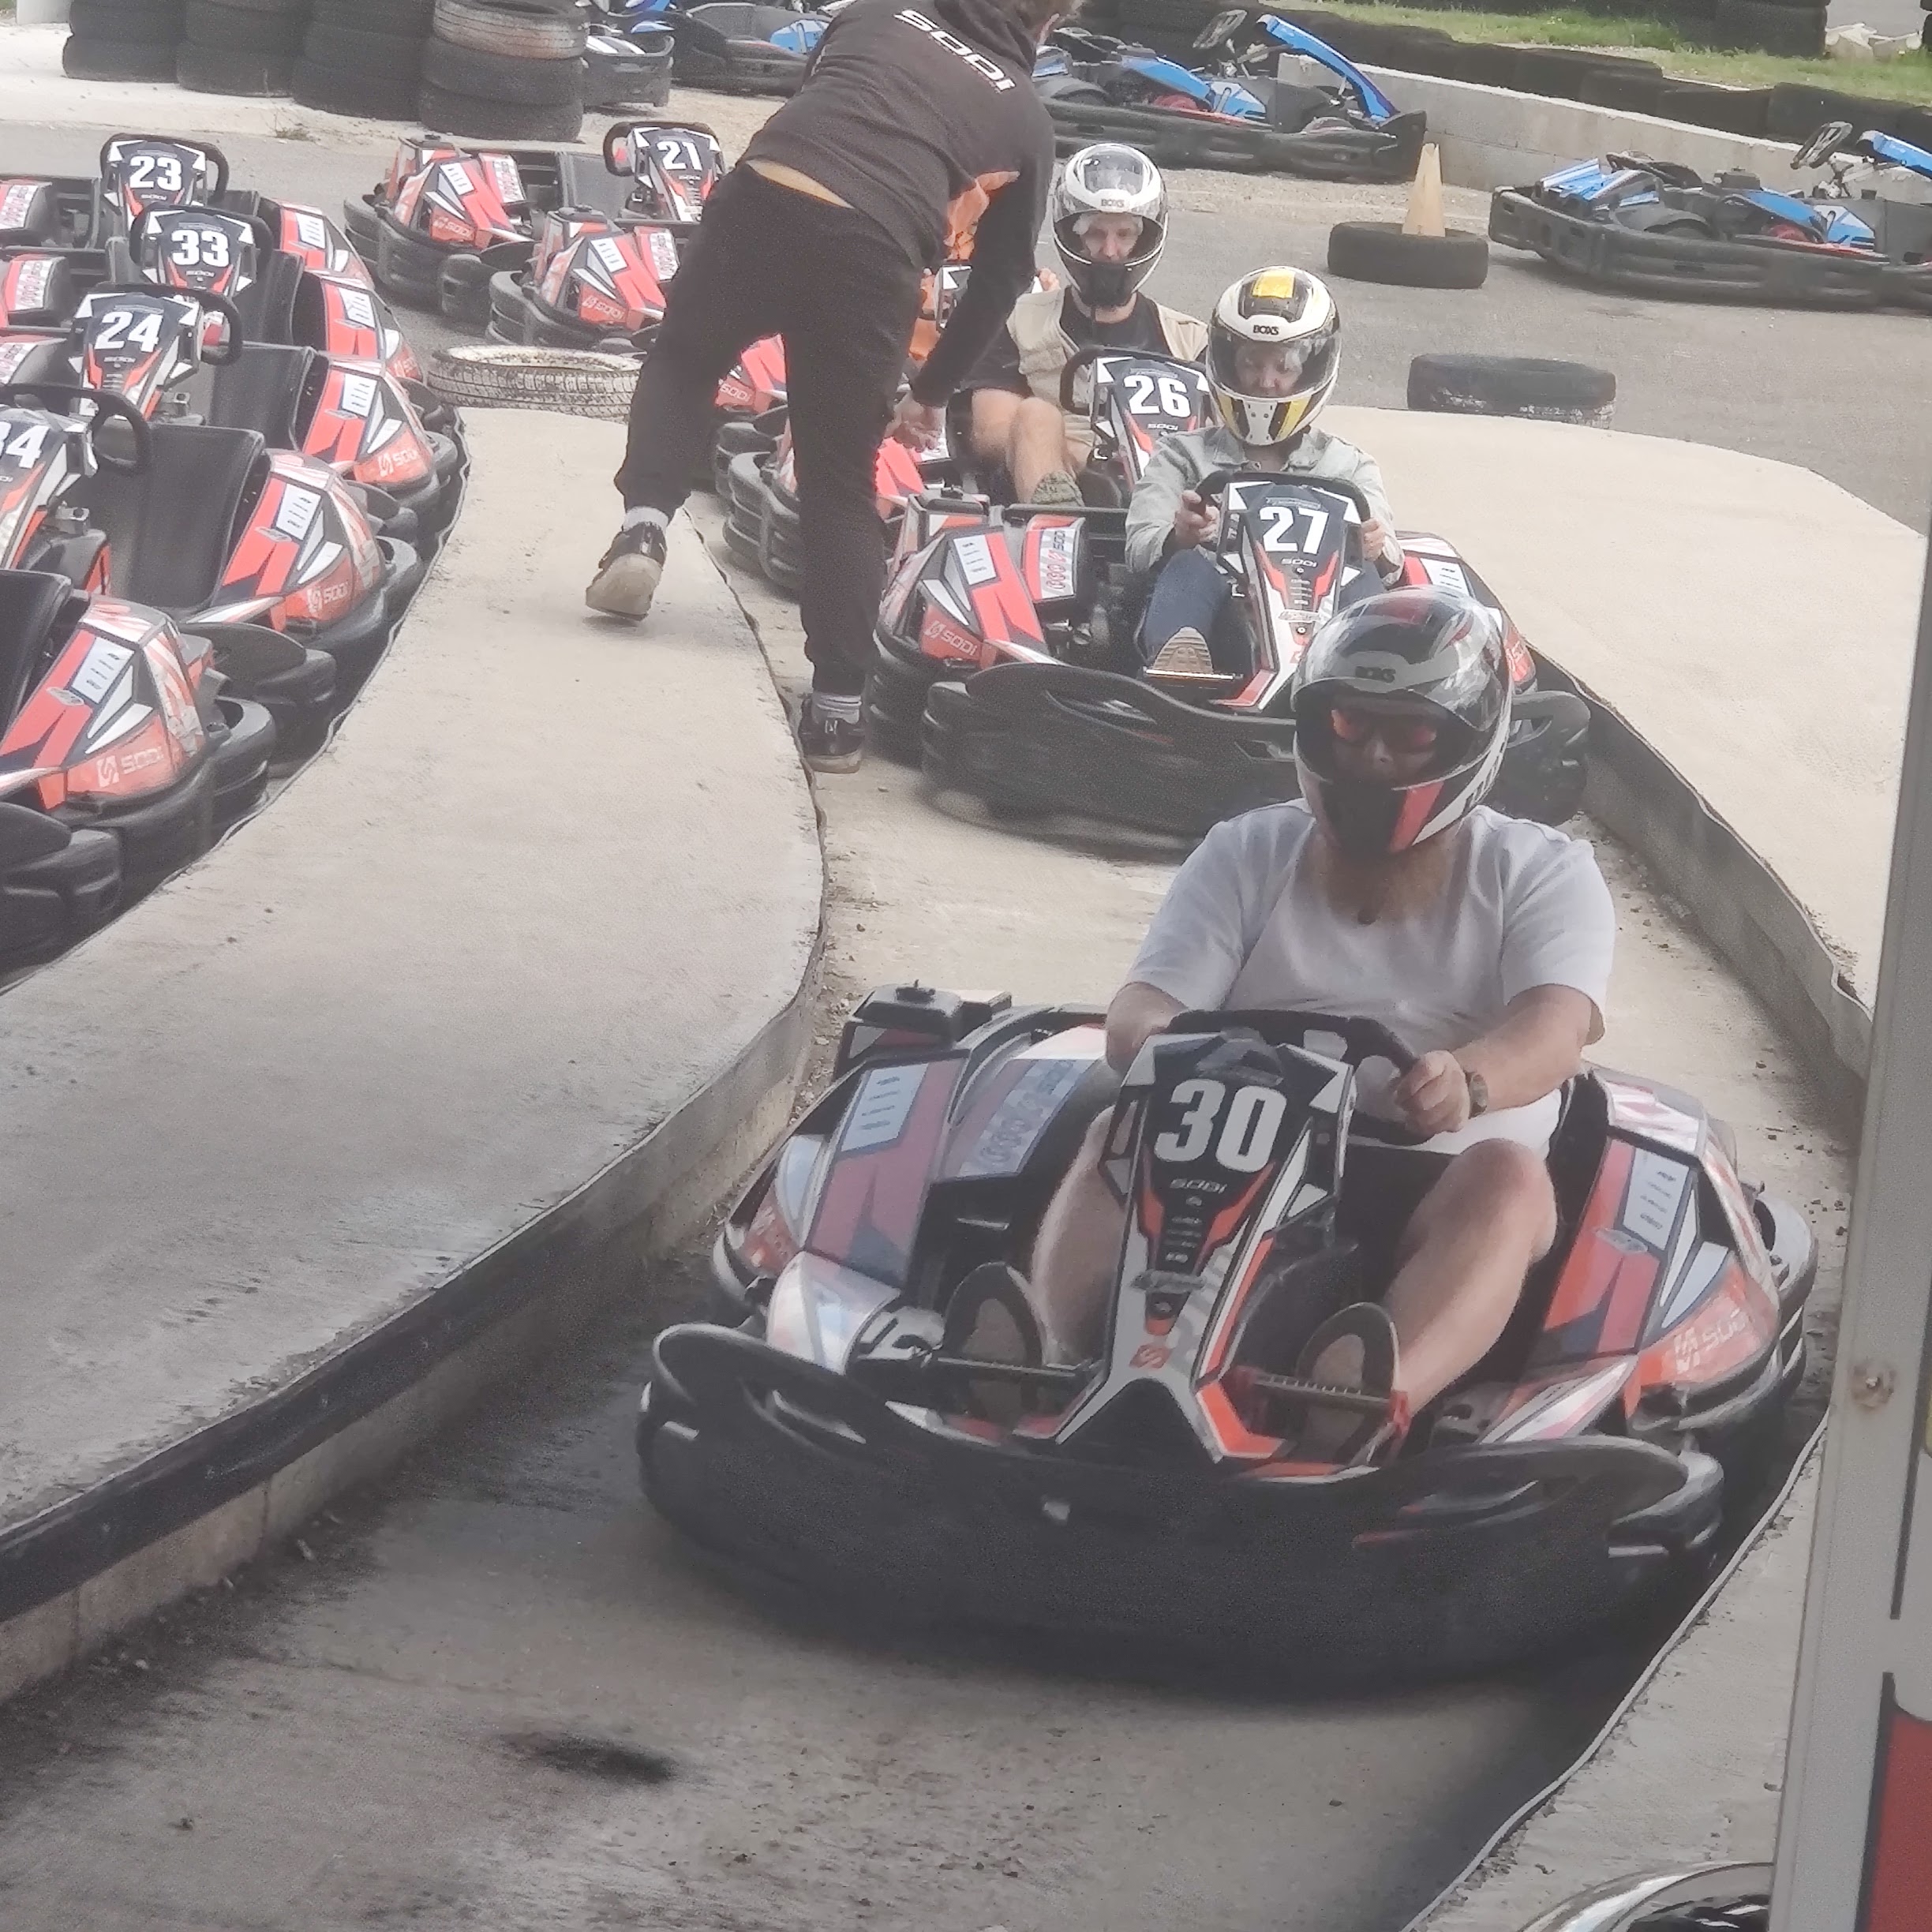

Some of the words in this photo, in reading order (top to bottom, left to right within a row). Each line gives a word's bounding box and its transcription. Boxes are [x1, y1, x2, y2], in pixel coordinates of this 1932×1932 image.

[129, 155, 182, 191] 23
[656, 140, 702, 171] 21
[171, 229, 230, 267] 33
[94, 311, 163, 353] 24
[1123, 375, 1192, 417] 26
[1260, 506, 1330, 554] 27
[1154, 1078, 1287, 1173] 30
